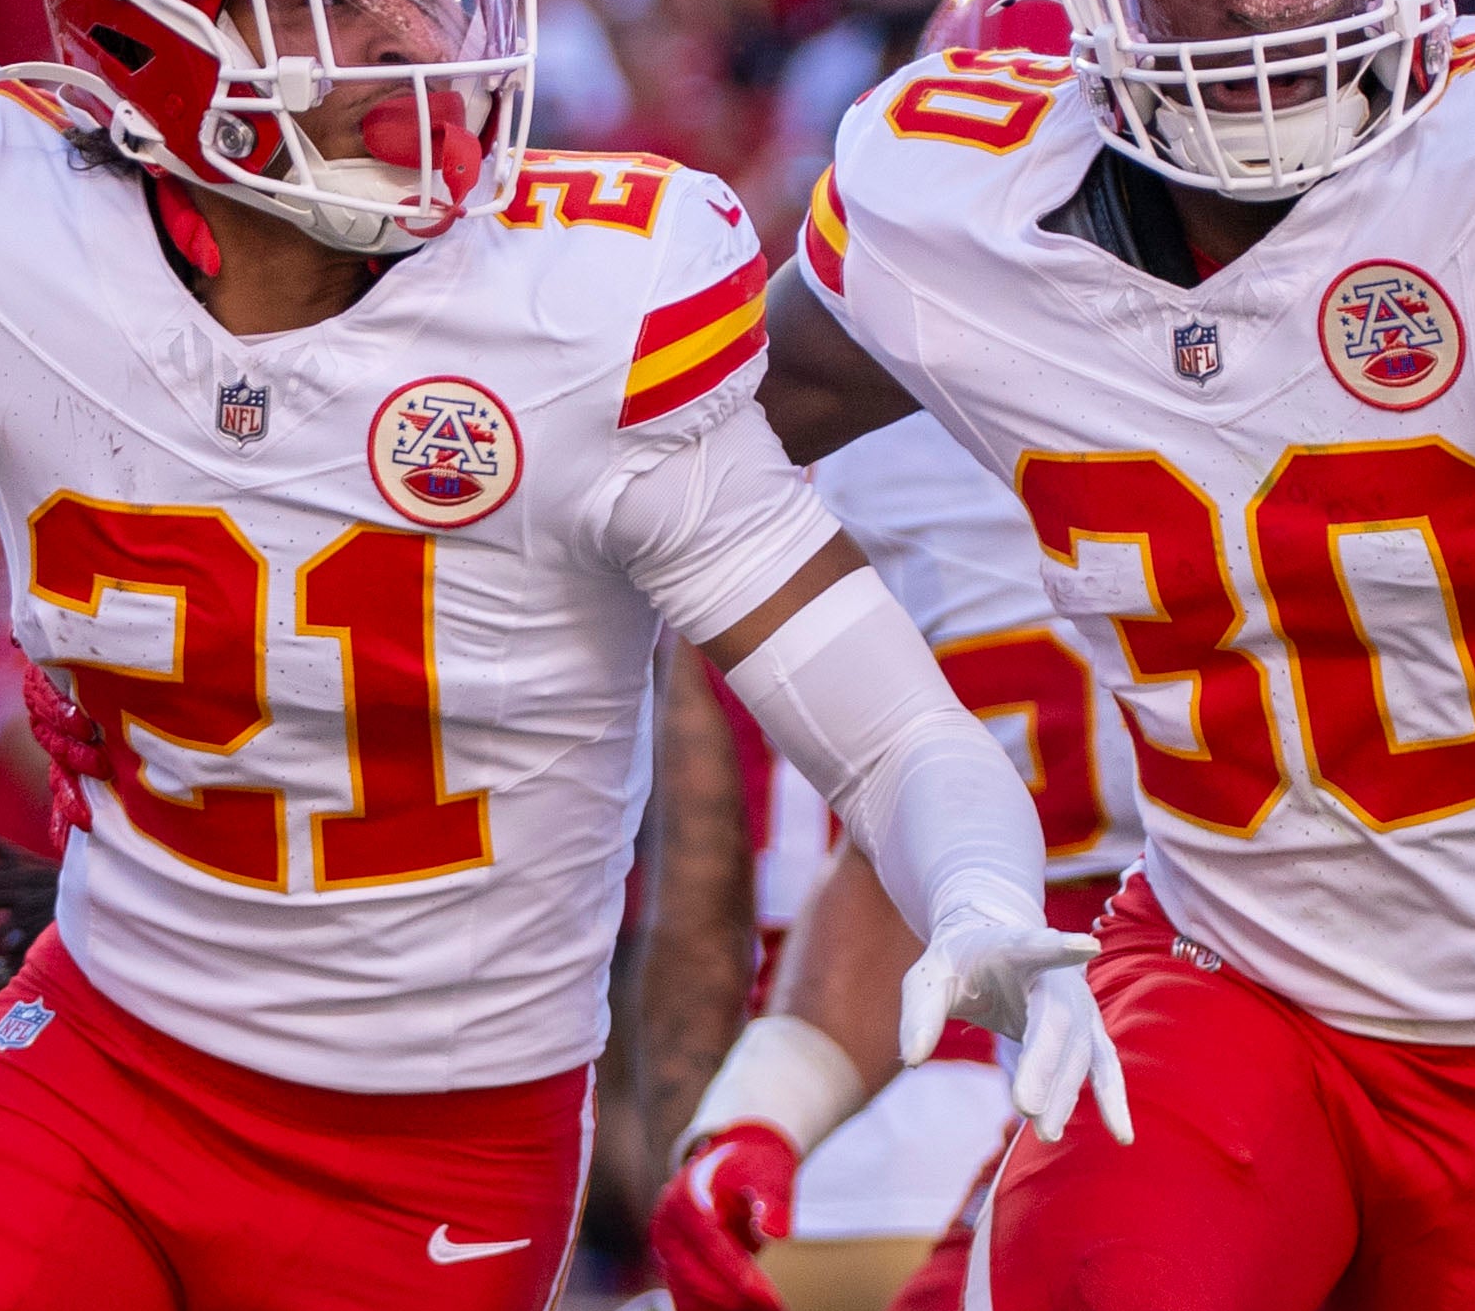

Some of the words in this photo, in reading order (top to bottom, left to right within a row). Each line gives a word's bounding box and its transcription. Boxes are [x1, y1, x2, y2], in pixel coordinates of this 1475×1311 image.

[1178, 346, 1216, 374] NFL
[223, 406, 260, 435] NFL
[28, 488, 493, 893] 21
